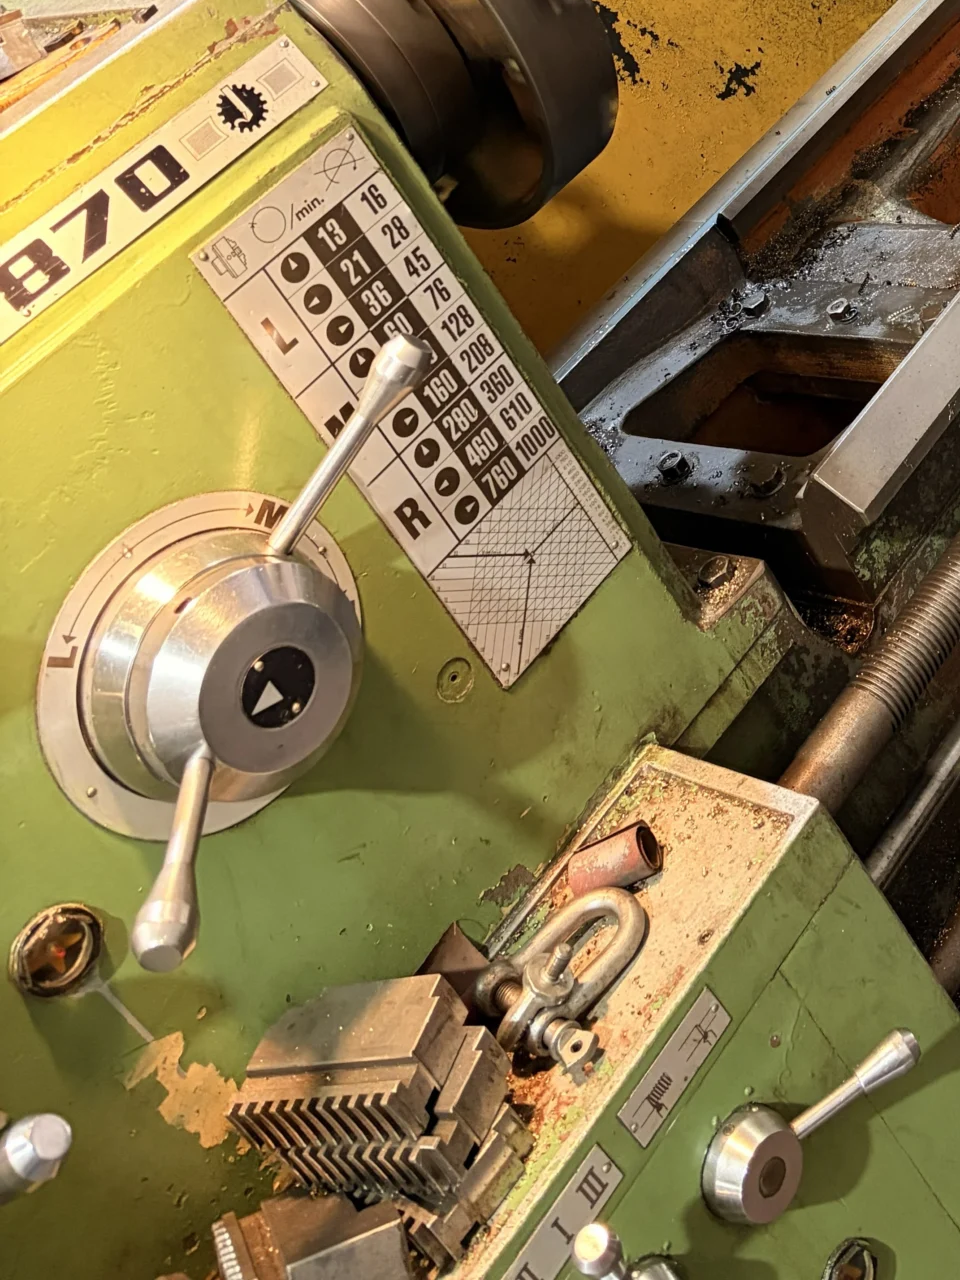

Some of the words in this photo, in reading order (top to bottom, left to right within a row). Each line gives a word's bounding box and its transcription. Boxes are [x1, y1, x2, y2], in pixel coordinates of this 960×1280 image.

[0, 144, 190, 312] 870
[317, 218, 347, 252] 13
[360, 184, 388, 215] 16
[340, 249, 372, 286] 21
[381, 215, 410, 250] 28
[361, 280, 393, 317] 36
[403, 246, 431, 278] 45
[423, 277, 451, 311] 76
[260, 317, 299, 355] L
[441, 304, 475, 342] 128
[423, 368, 458, 409] 160
[459, 333, 495, 375] 208
[441, 398, 478, 442] 280
[480, 364, 515, 404] 360
[464, 427, 499, 467] 460
[500, 392, 533, 431] 610
[481, 456, 518, 499] 760
[515, 416, 556, 462] 1000
[393, 497, 433, 541] R
[47, 645, 78, 669] L
